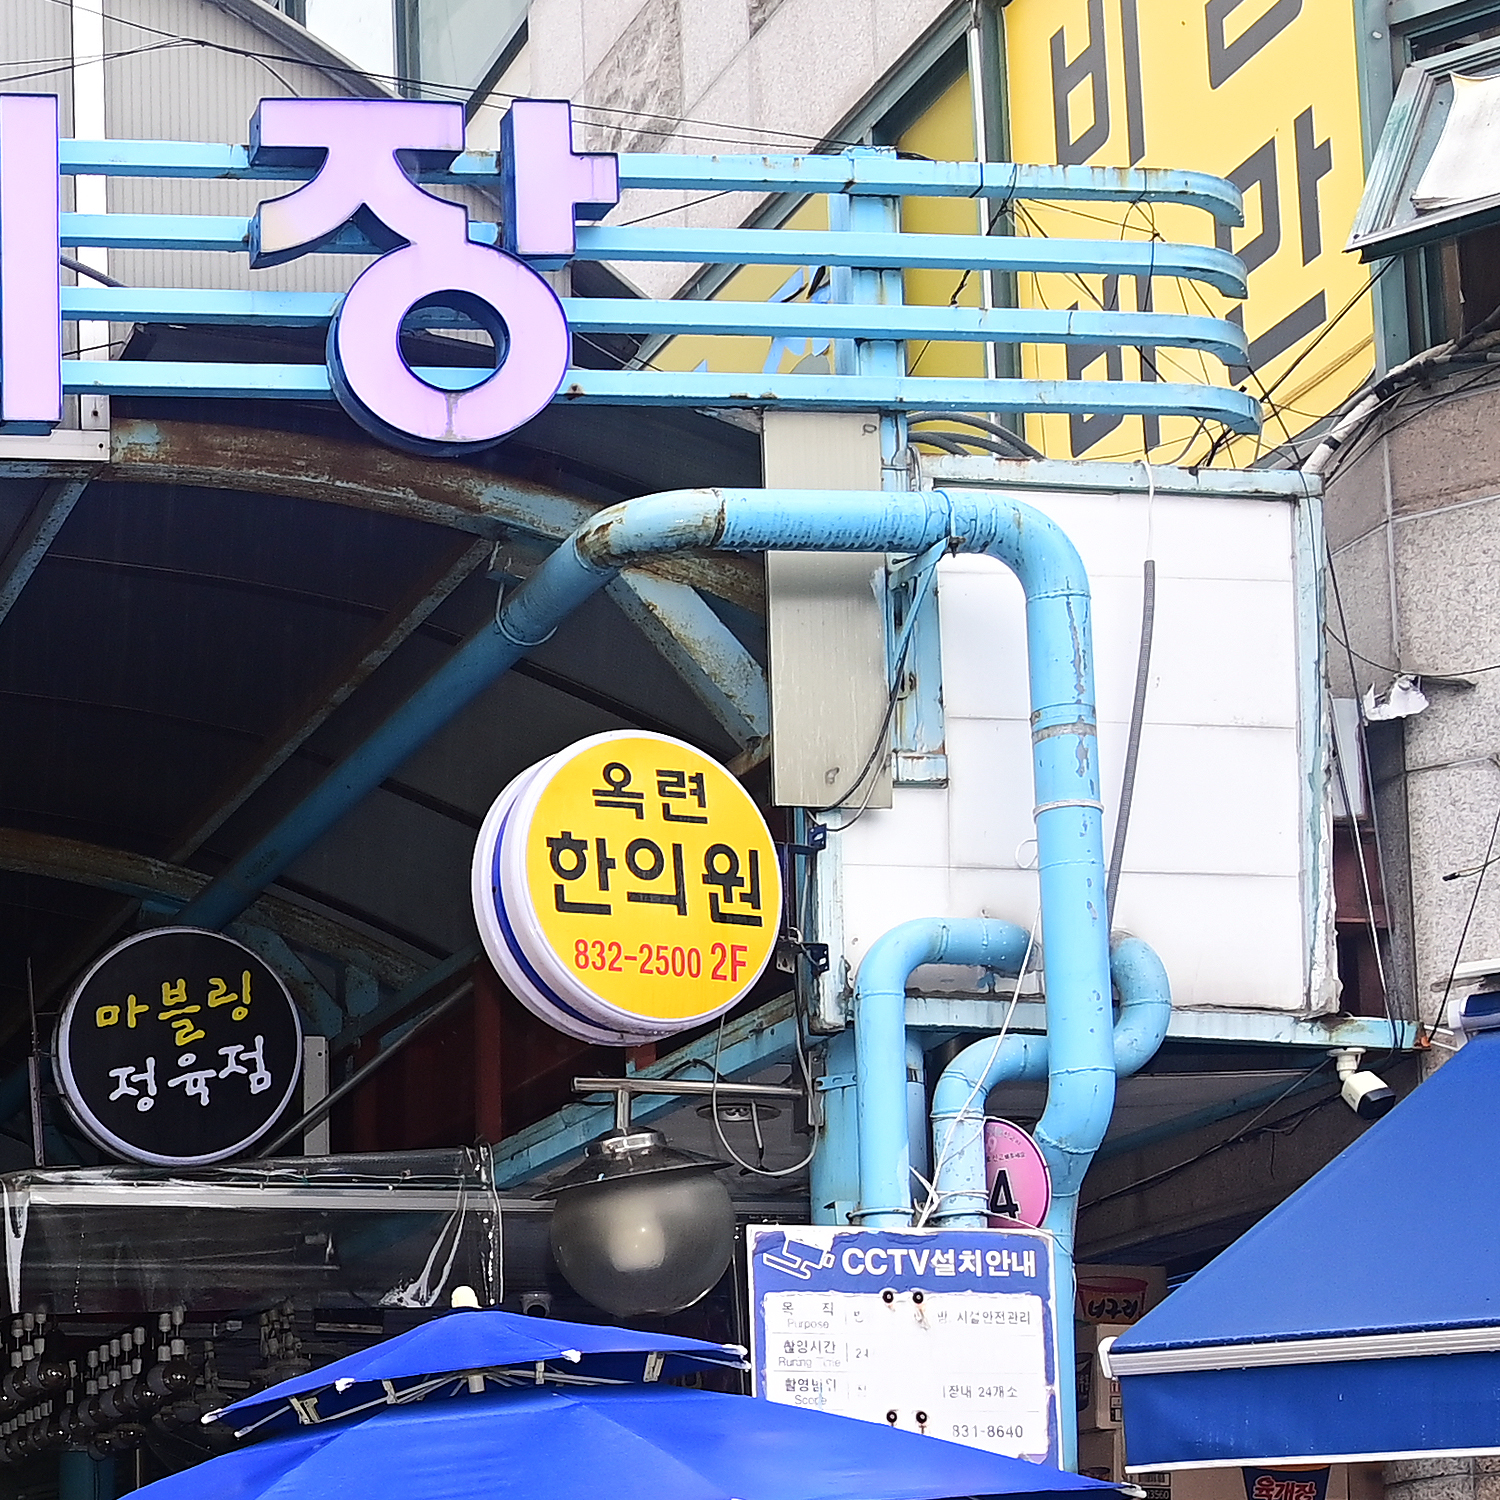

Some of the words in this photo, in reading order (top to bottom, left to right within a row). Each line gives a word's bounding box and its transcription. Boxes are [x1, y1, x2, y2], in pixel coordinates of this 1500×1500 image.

[593, 761, 708, 824] 옥련
[546, 831, 763, 927] 한의원
[573, 939, 702, 979] 832-2500
[710, 941, 748, 982] 2F
[95, 971, 252, 1046] 마블링
[109, 1036, 271, 1111] 정육점
[989, 1169, 1019, 1218] 4
[841, 1247, 1037, 1279] CCTV설치안내
